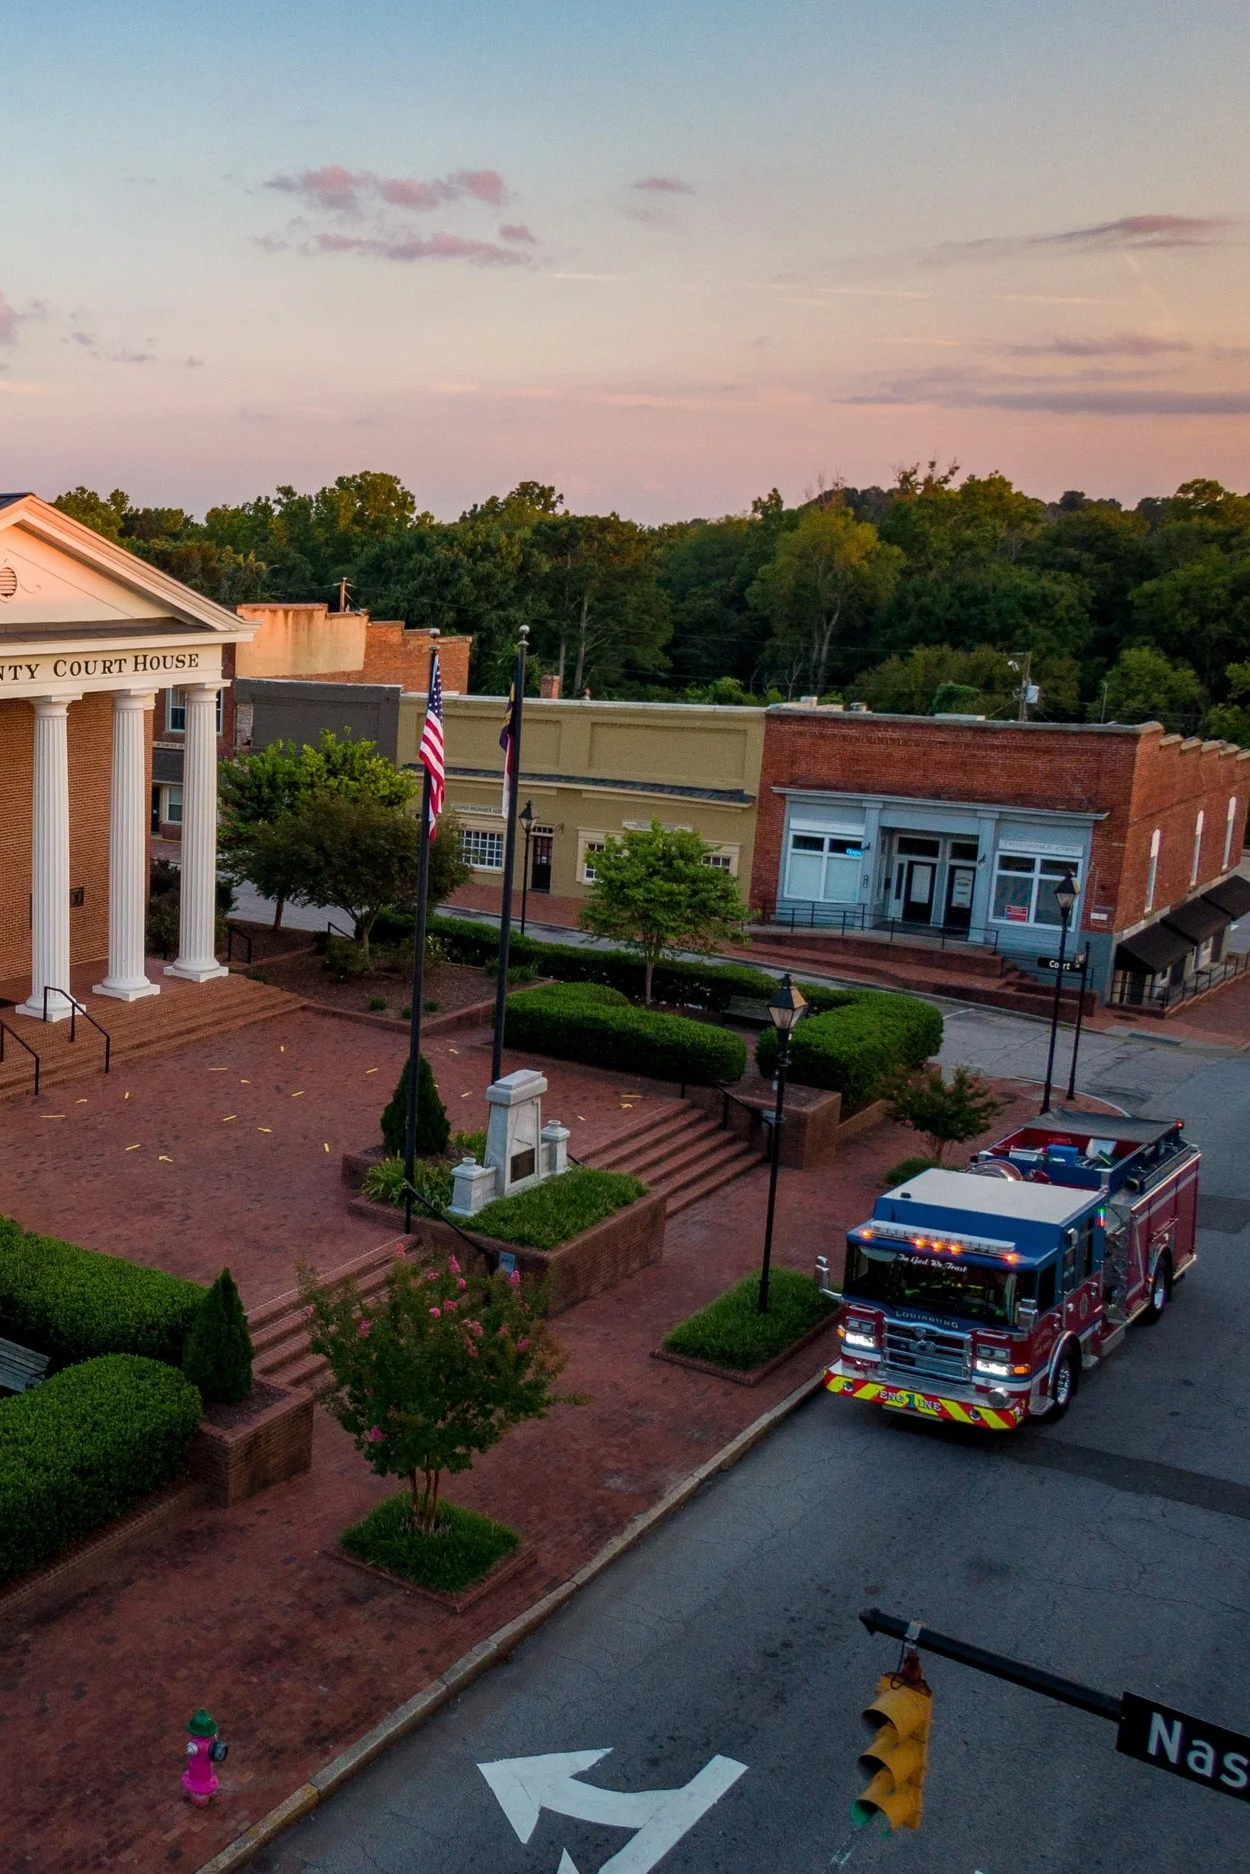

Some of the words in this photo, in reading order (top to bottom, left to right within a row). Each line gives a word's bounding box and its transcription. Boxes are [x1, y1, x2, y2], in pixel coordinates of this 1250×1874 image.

[53, 658, 127, 678] COURT
[133, 653, 199, 673] HOUSE
[1049, 959, 1071, 970] Cort
[897, 1253, 909, 1261] In
[910, 1255, 929, 1266] God
[930, 1259, 943, 1268] We
[944, 1262, 967, 1273] Trust
